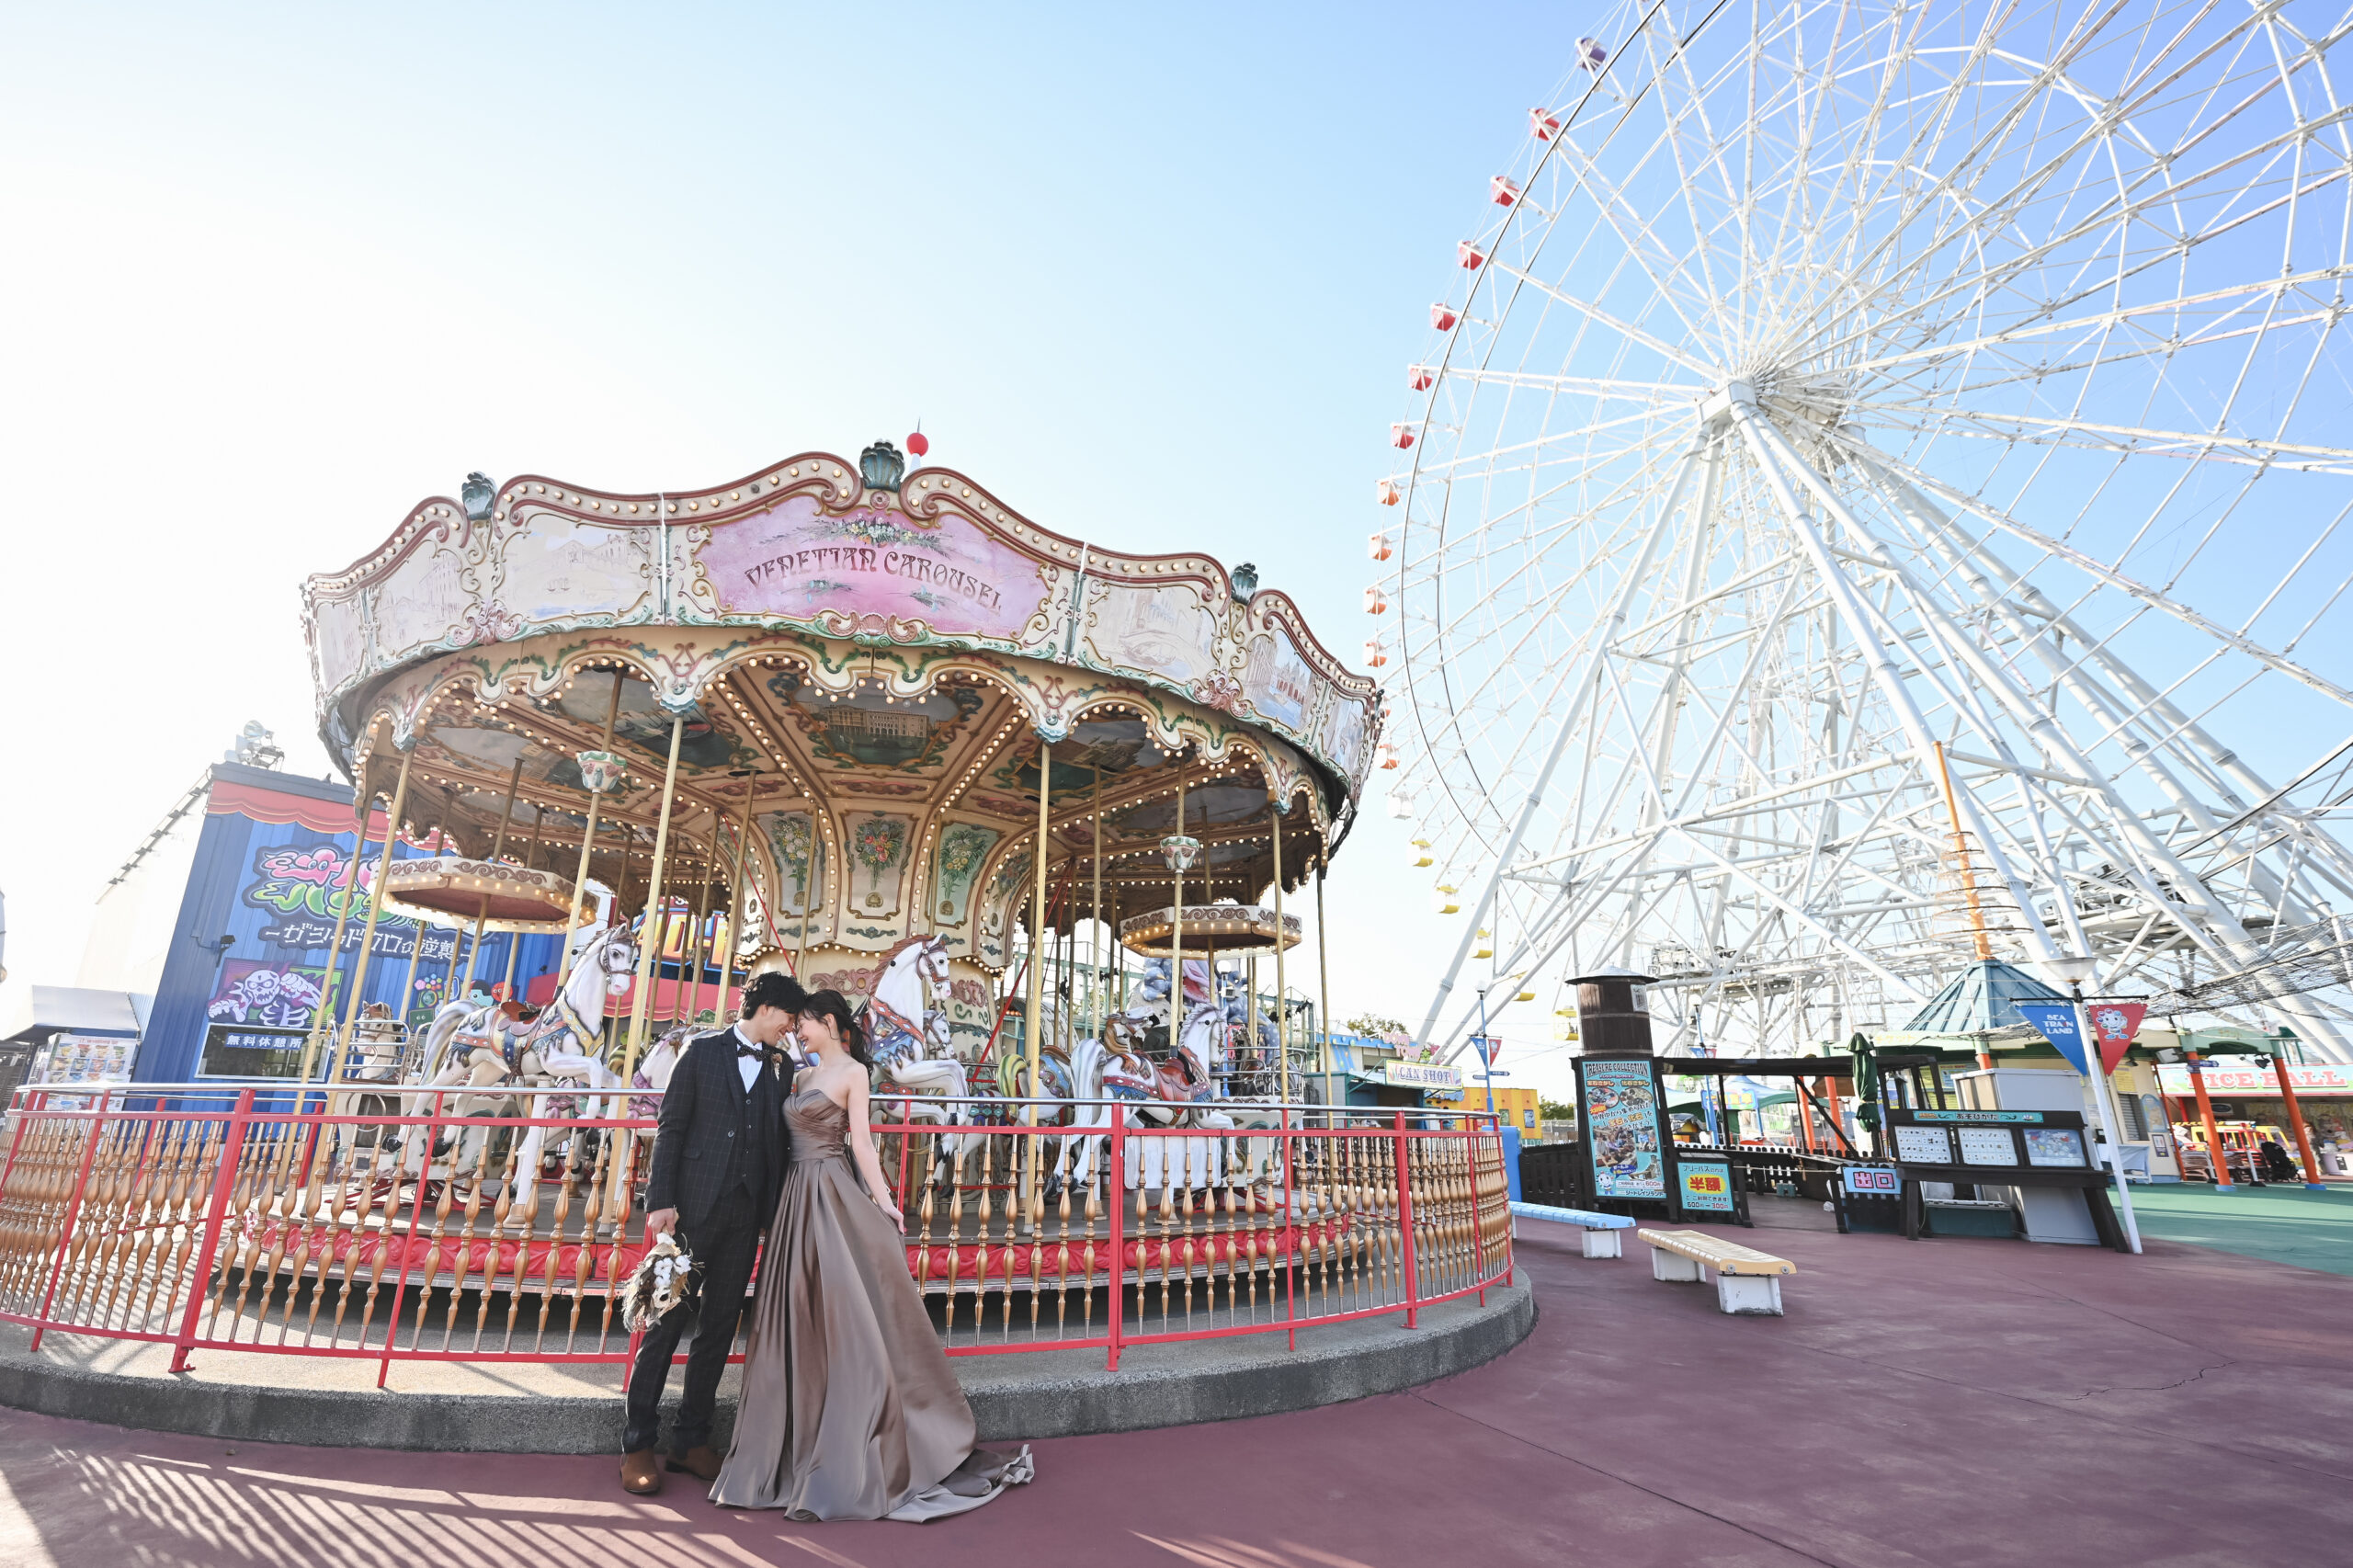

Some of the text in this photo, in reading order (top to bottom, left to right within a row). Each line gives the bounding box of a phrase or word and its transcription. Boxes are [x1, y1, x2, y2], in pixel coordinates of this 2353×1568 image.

[744, 548, 1002, 615] VENETIAN CAROUSEL
[226, 1034, 302, 1050] 無料休憩所
[1399, 1066, 1449, 1082] CAN SHOT
[1586, 1062, 1648, 1077] TREASURE COLLECTION
[1689, 1176, 1722, 1192] 半額
[1852, 1170, 1895, 1189] 出口
